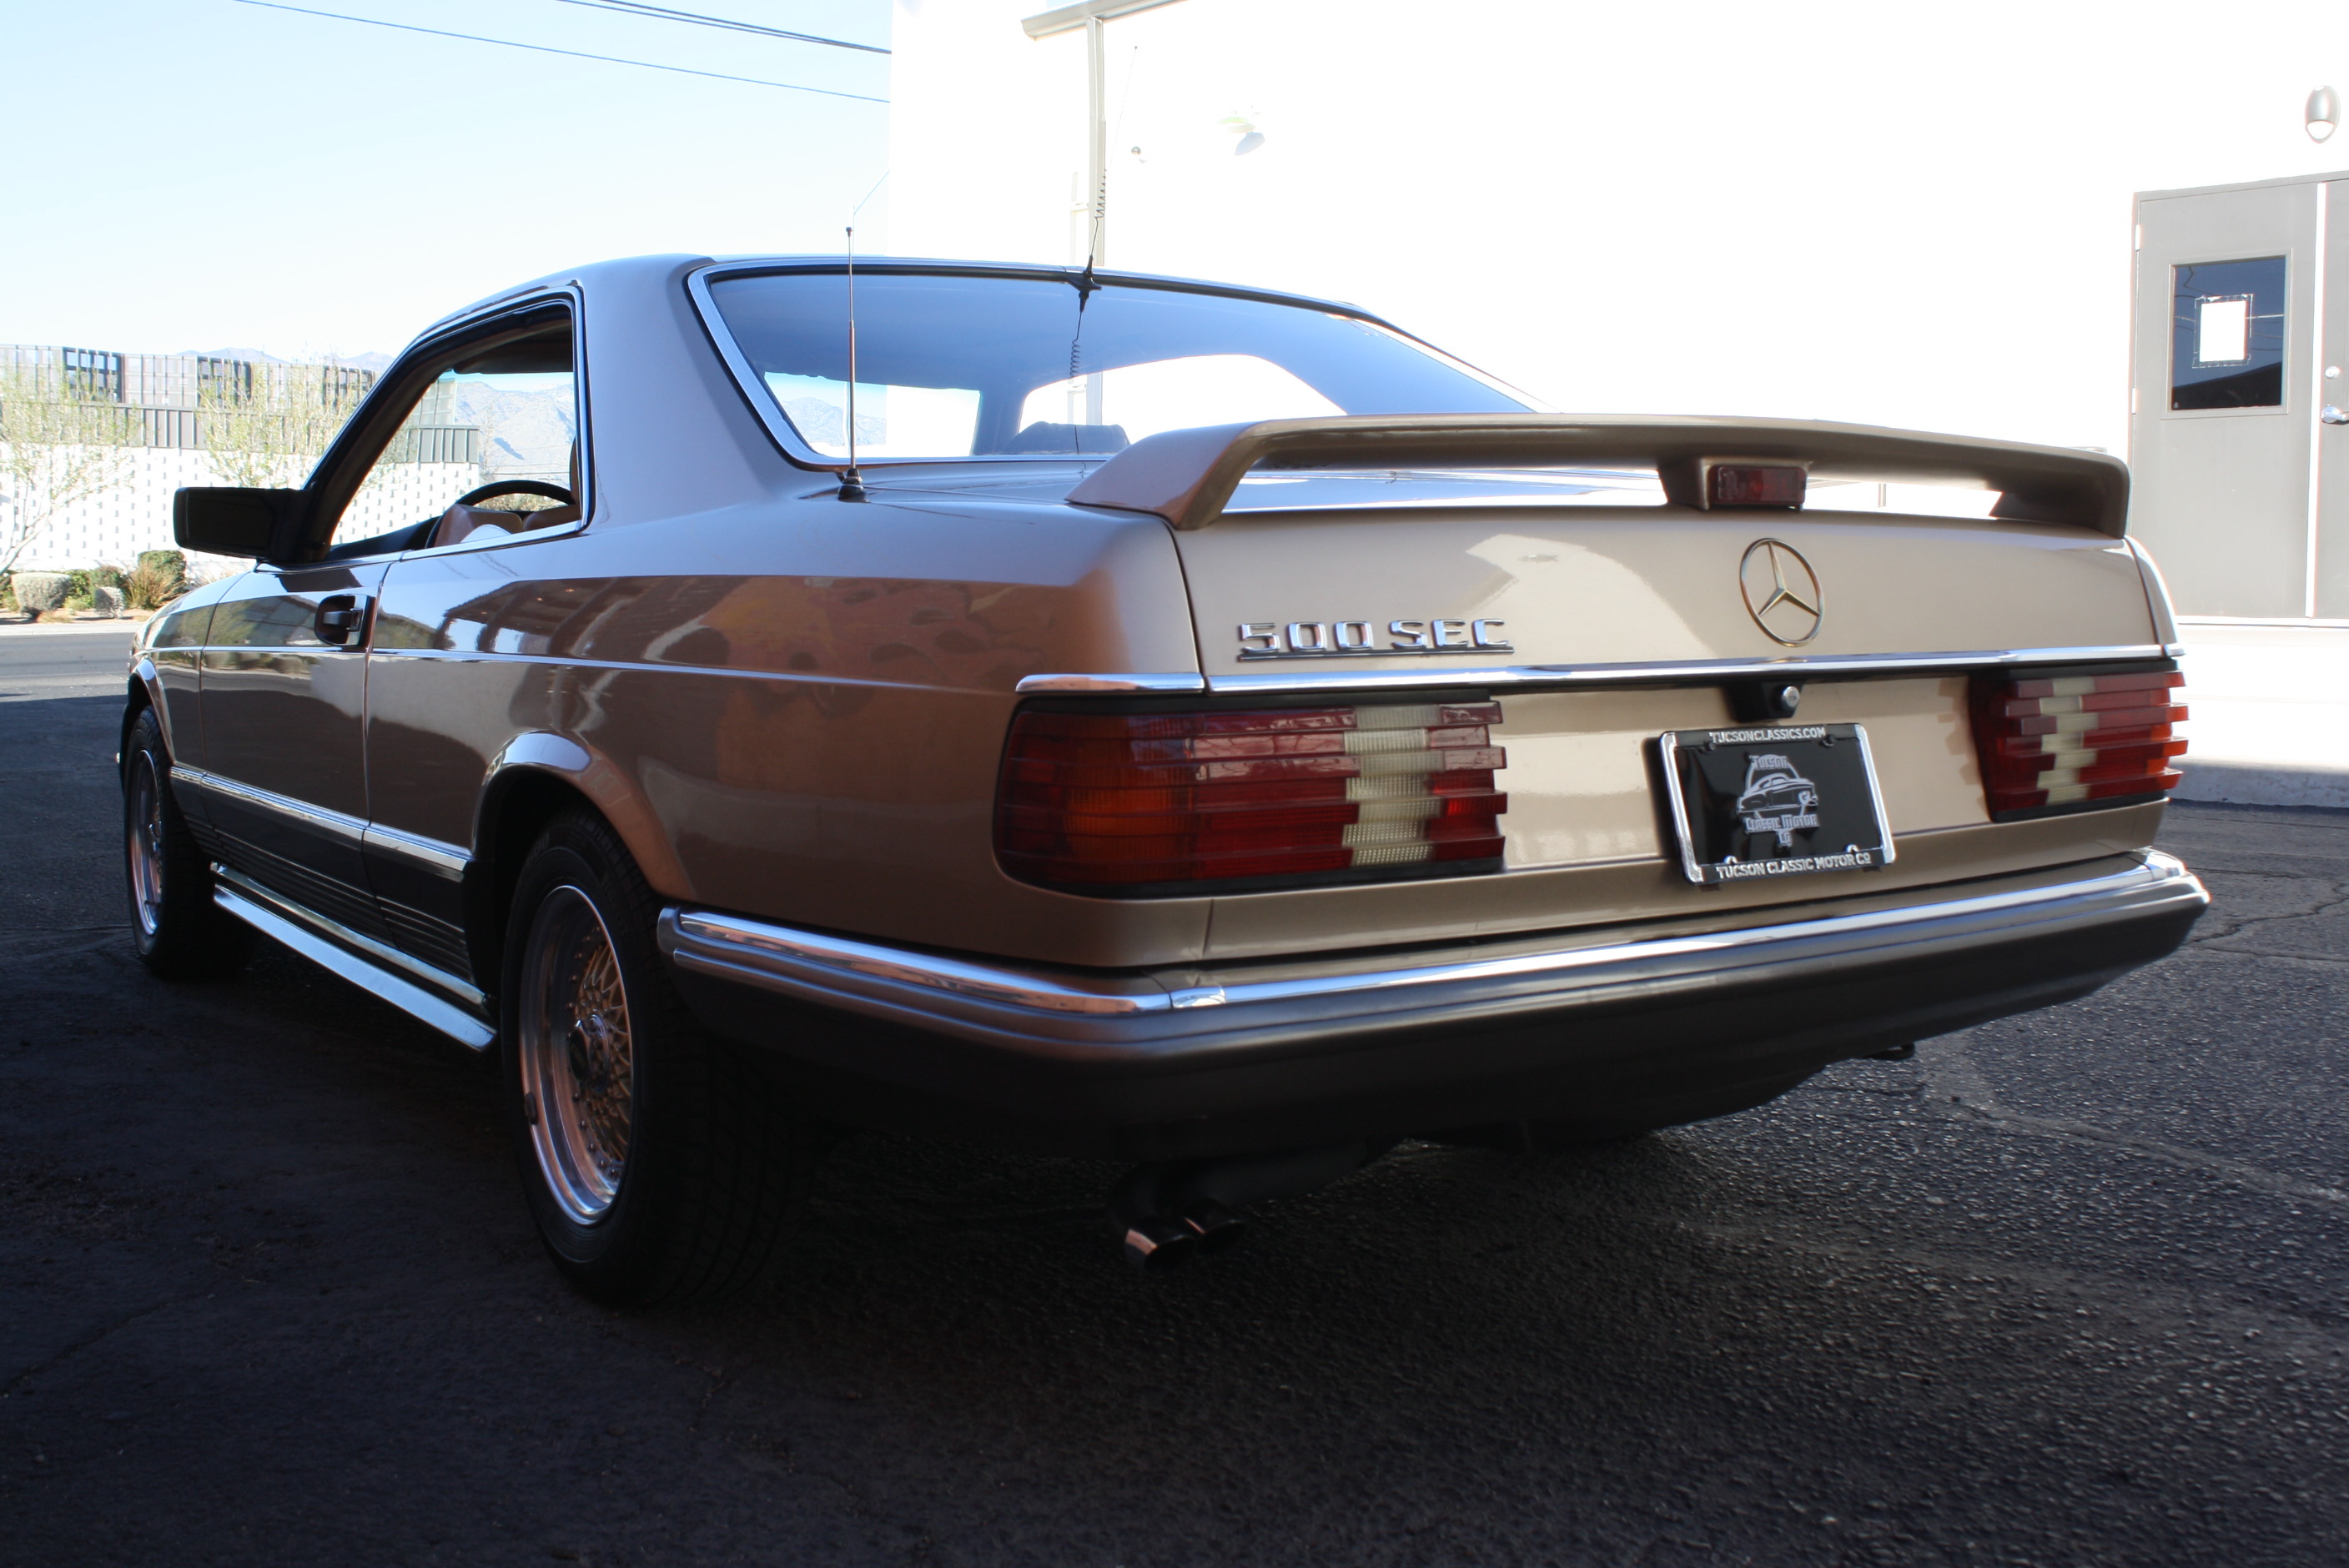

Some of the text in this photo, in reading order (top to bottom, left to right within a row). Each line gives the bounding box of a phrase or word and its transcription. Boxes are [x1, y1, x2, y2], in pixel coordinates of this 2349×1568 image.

[1240, 618, 1509, 652] 500 SEC
[1710, 726, 1826, 743] TUCSONCLASSICS.COM
[1716, 862, 1765, 878] TUCSON
[1767, 857, 1813, 873] CLASSIC
[1814, 853, 1856, 869] MOTOR
